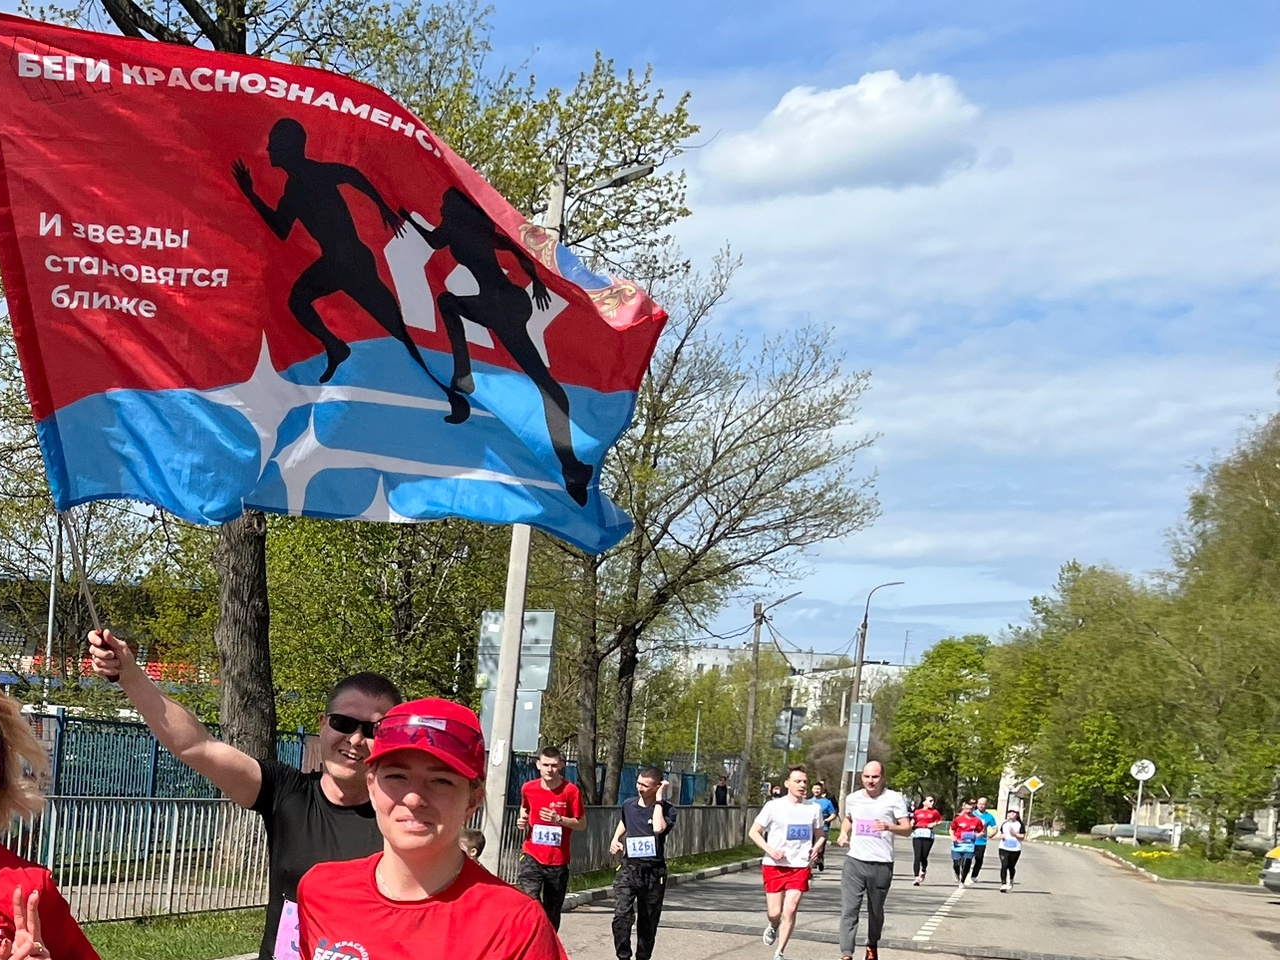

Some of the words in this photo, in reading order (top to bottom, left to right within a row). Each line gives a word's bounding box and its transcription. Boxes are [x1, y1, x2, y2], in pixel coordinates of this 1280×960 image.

[18, 52, 111, 83] БЕГИ
[39, 212, 62, 237] И
[72, 222, 189, 250] звезды
[45, 255, 229, 287] становятся
[51, 284, 157, 318] ближе
[538, 831, 557, 841] 143
[632, 842, 650, 851] 126
[790, 828, 808, 837] 243
